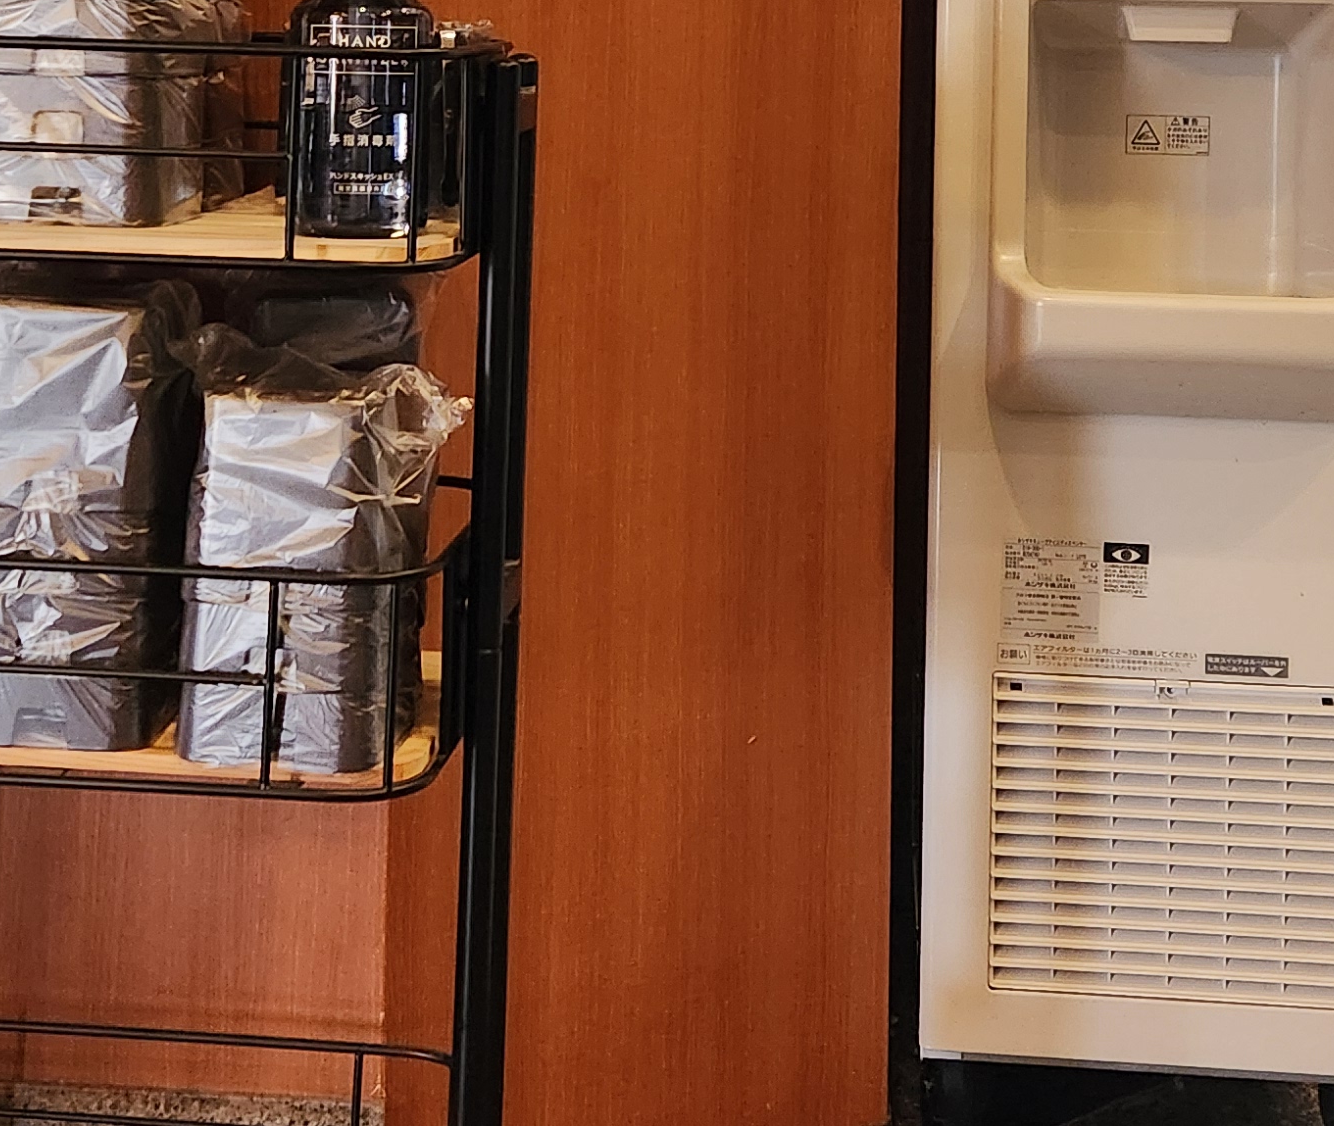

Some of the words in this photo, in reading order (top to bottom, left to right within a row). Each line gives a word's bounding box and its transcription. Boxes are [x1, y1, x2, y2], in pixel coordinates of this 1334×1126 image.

[338, 35, 392, 48] HAND
[999, 648, 1028, 660] お願い
